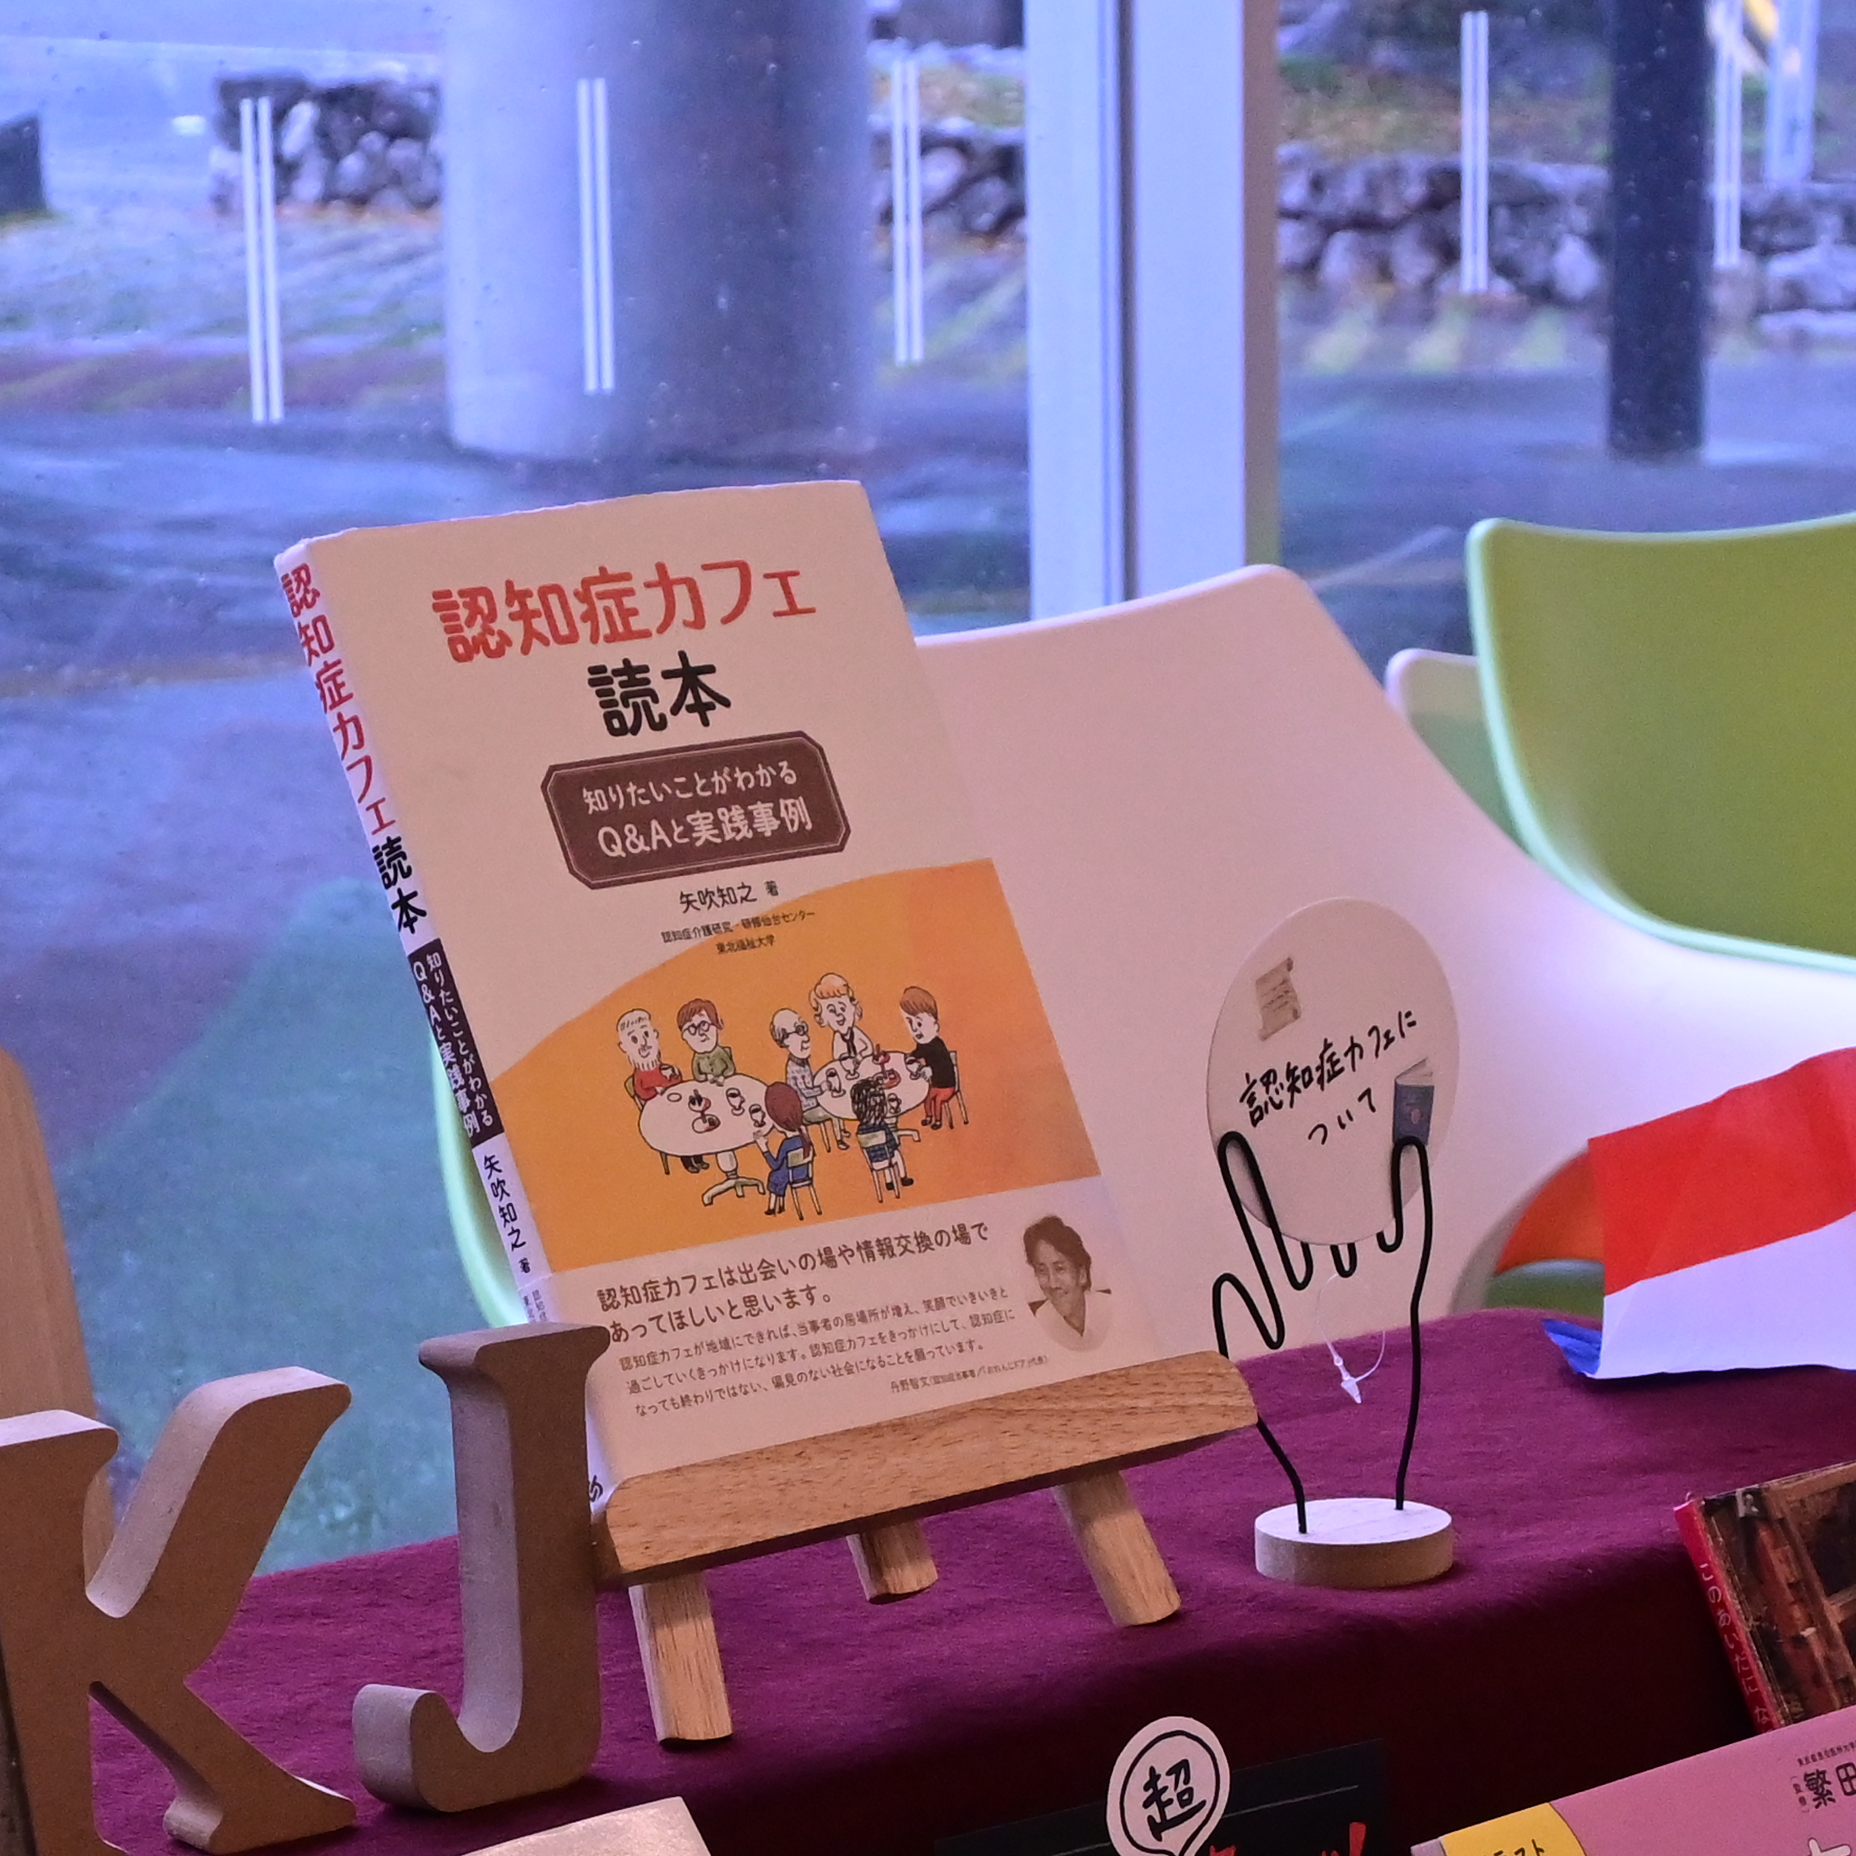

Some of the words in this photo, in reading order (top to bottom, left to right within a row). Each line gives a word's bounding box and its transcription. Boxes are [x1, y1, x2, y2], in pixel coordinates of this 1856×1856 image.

[431, 559, 817, 663] 認知症カフェ
[587, 651, 731, 737] 読本
[281, 563, 428, 936] 認知症カフェ読本
[582, 760, 797, 814] 知りたいことがわかる
[597, 797, 812, 860] Q&Aと実践事例
[679, 882, 757, 913] 矢吹知之
[765, 880, 779, 896] 著
[425, 952, 495, 1129] 知りたいことがわかる
[1240, 1011, 1418, 1128] 認知症カフェに
[1308, 1088, 1377, 1146] ついて
[483, 1153, 528, 1250] 矢吹知之
[597, 1222, 989, 1312] 認知症カフェは出会いの場や情報交換の場で
[610, 1285, 832, 1344] あってほしいと思います。
[1142, 1759, 1207, 1842] 超
